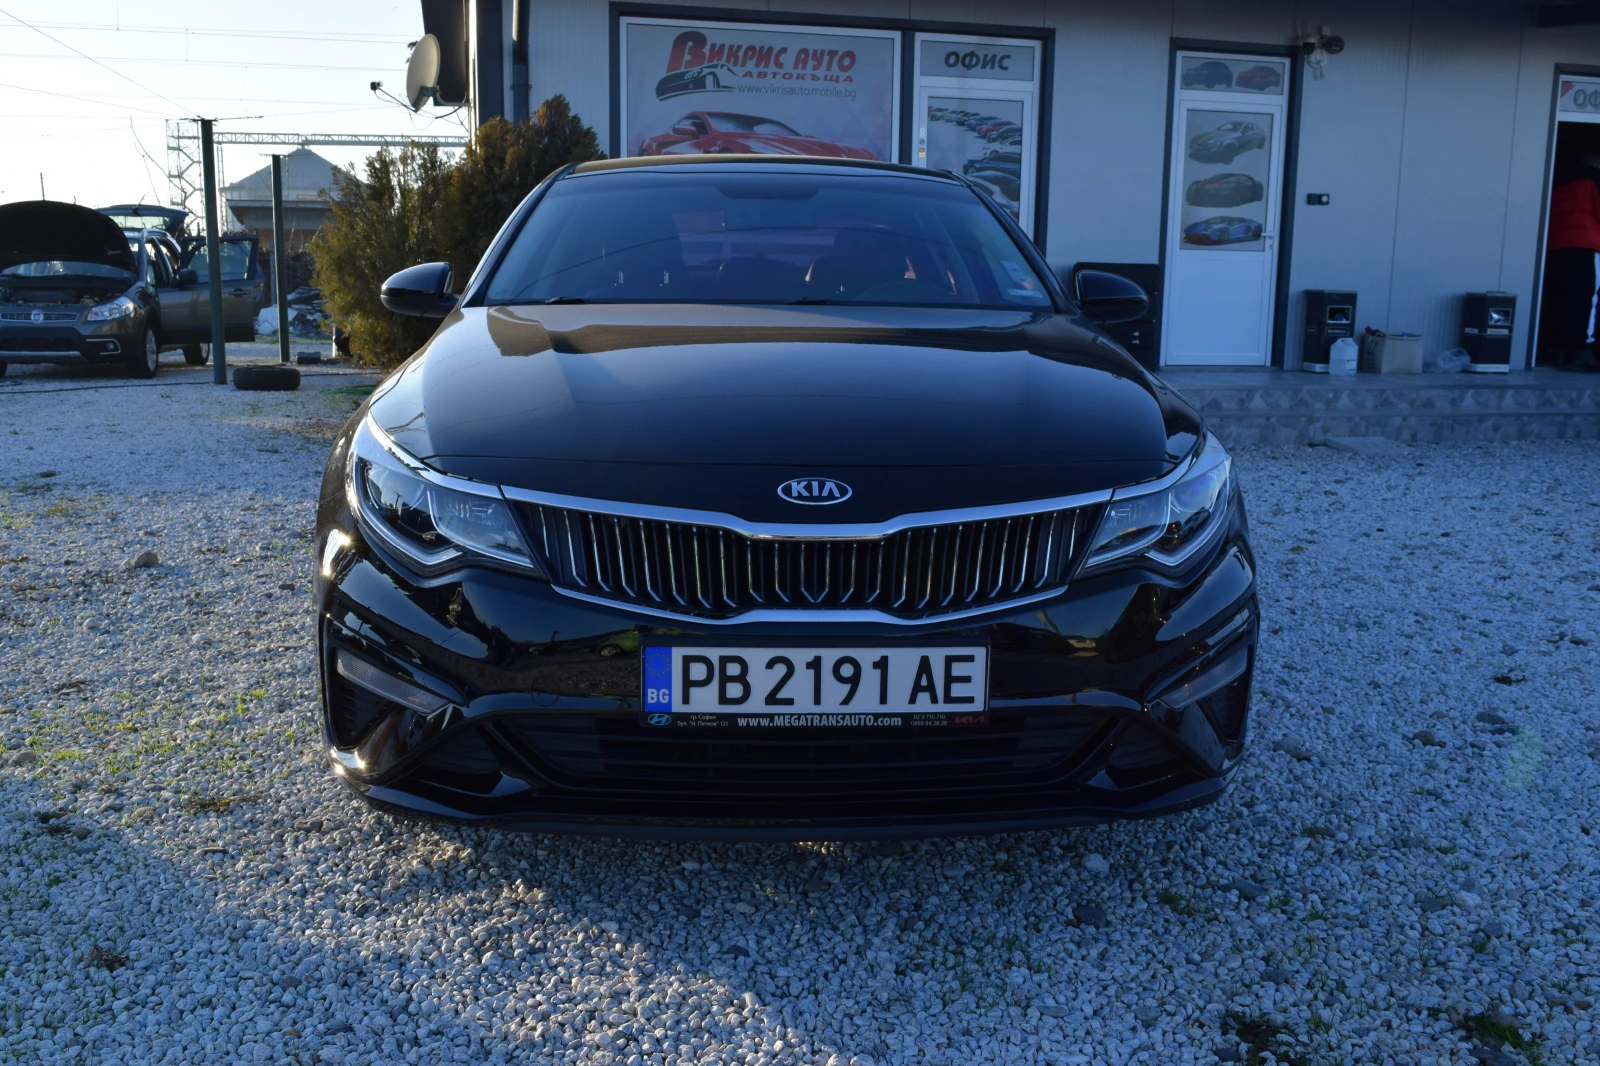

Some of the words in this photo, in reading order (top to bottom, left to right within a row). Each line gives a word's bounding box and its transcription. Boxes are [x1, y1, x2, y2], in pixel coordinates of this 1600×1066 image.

[944, 50, 1012, 71] ОФИС
[742, 70, 855, 84] АВТОКЪЩА
[737, 83, 857, 101] www.vikrisauto.mobile.bg
[790, 481, 841, 498] KIA
[647, 689, 670, 704] BG
[737, 713, 902, 728] www.MEGATRANSAUTO.com
